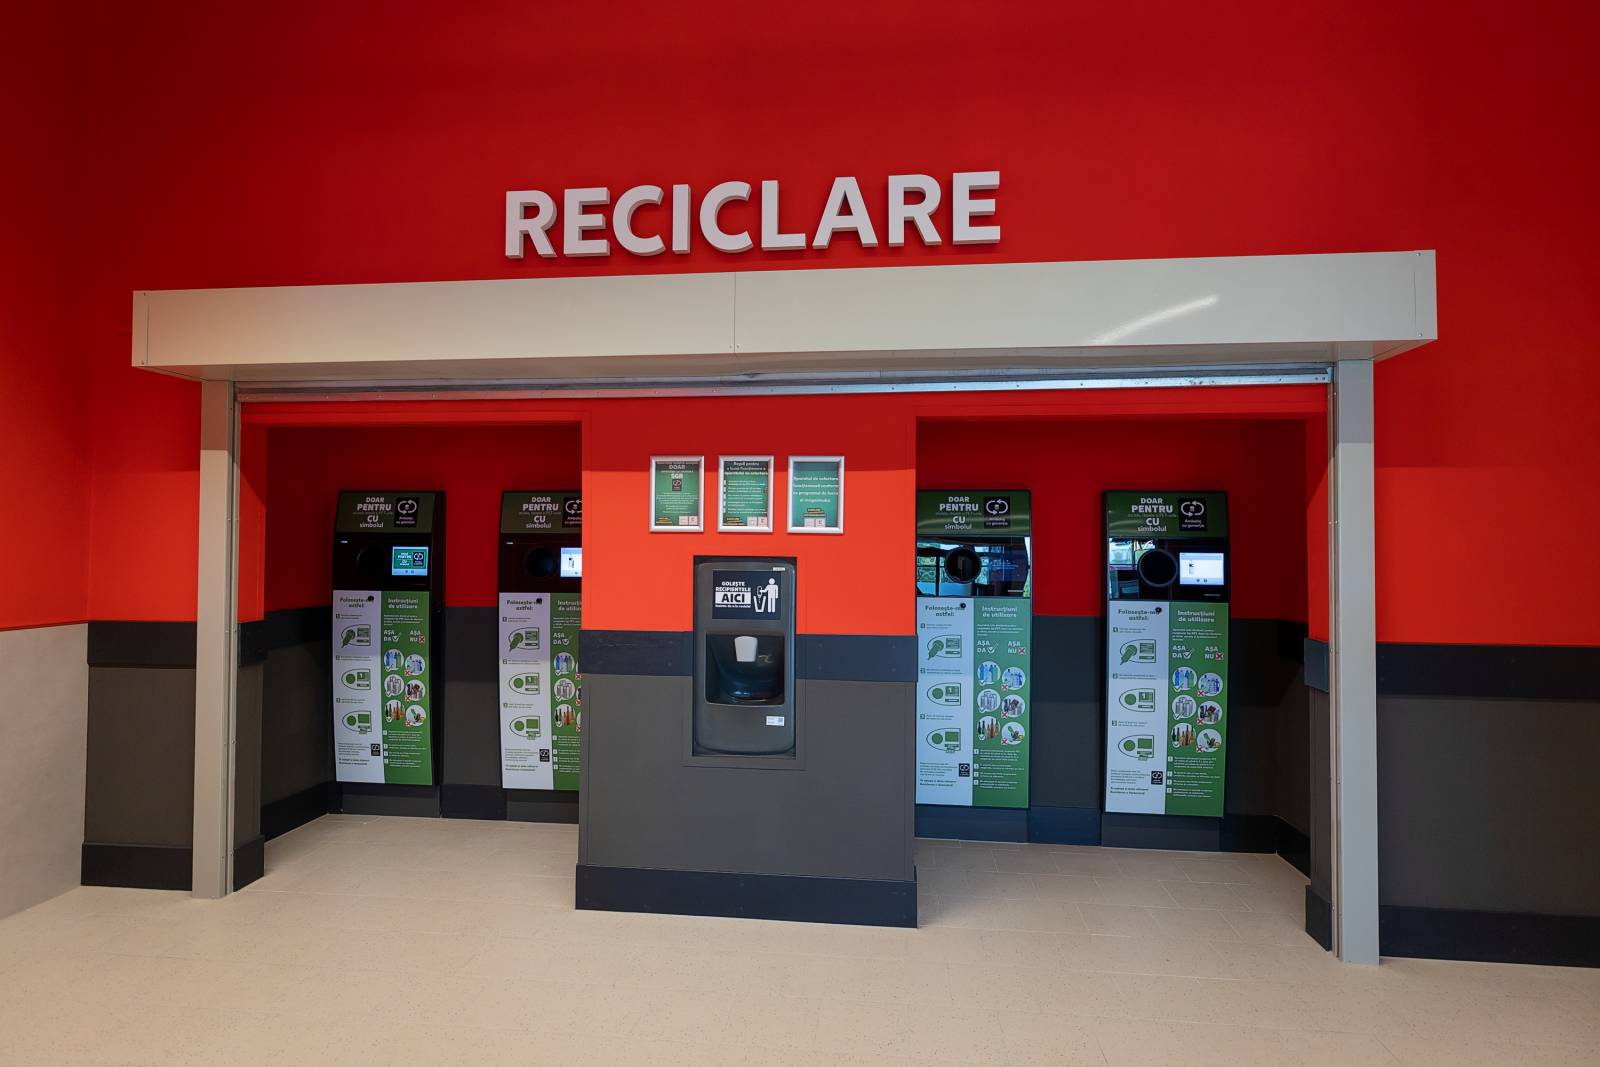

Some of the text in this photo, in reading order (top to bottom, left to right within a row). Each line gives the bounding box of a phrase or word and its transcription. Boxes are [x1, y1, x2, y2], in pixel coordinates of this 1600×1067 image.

[504, 170, 1001, 257] RECICLARE
[939, 503, 979, 512] PENTRU
[1131, 505, 1173, 513] PENTRU
[722, 593, 744, 602] AICI
